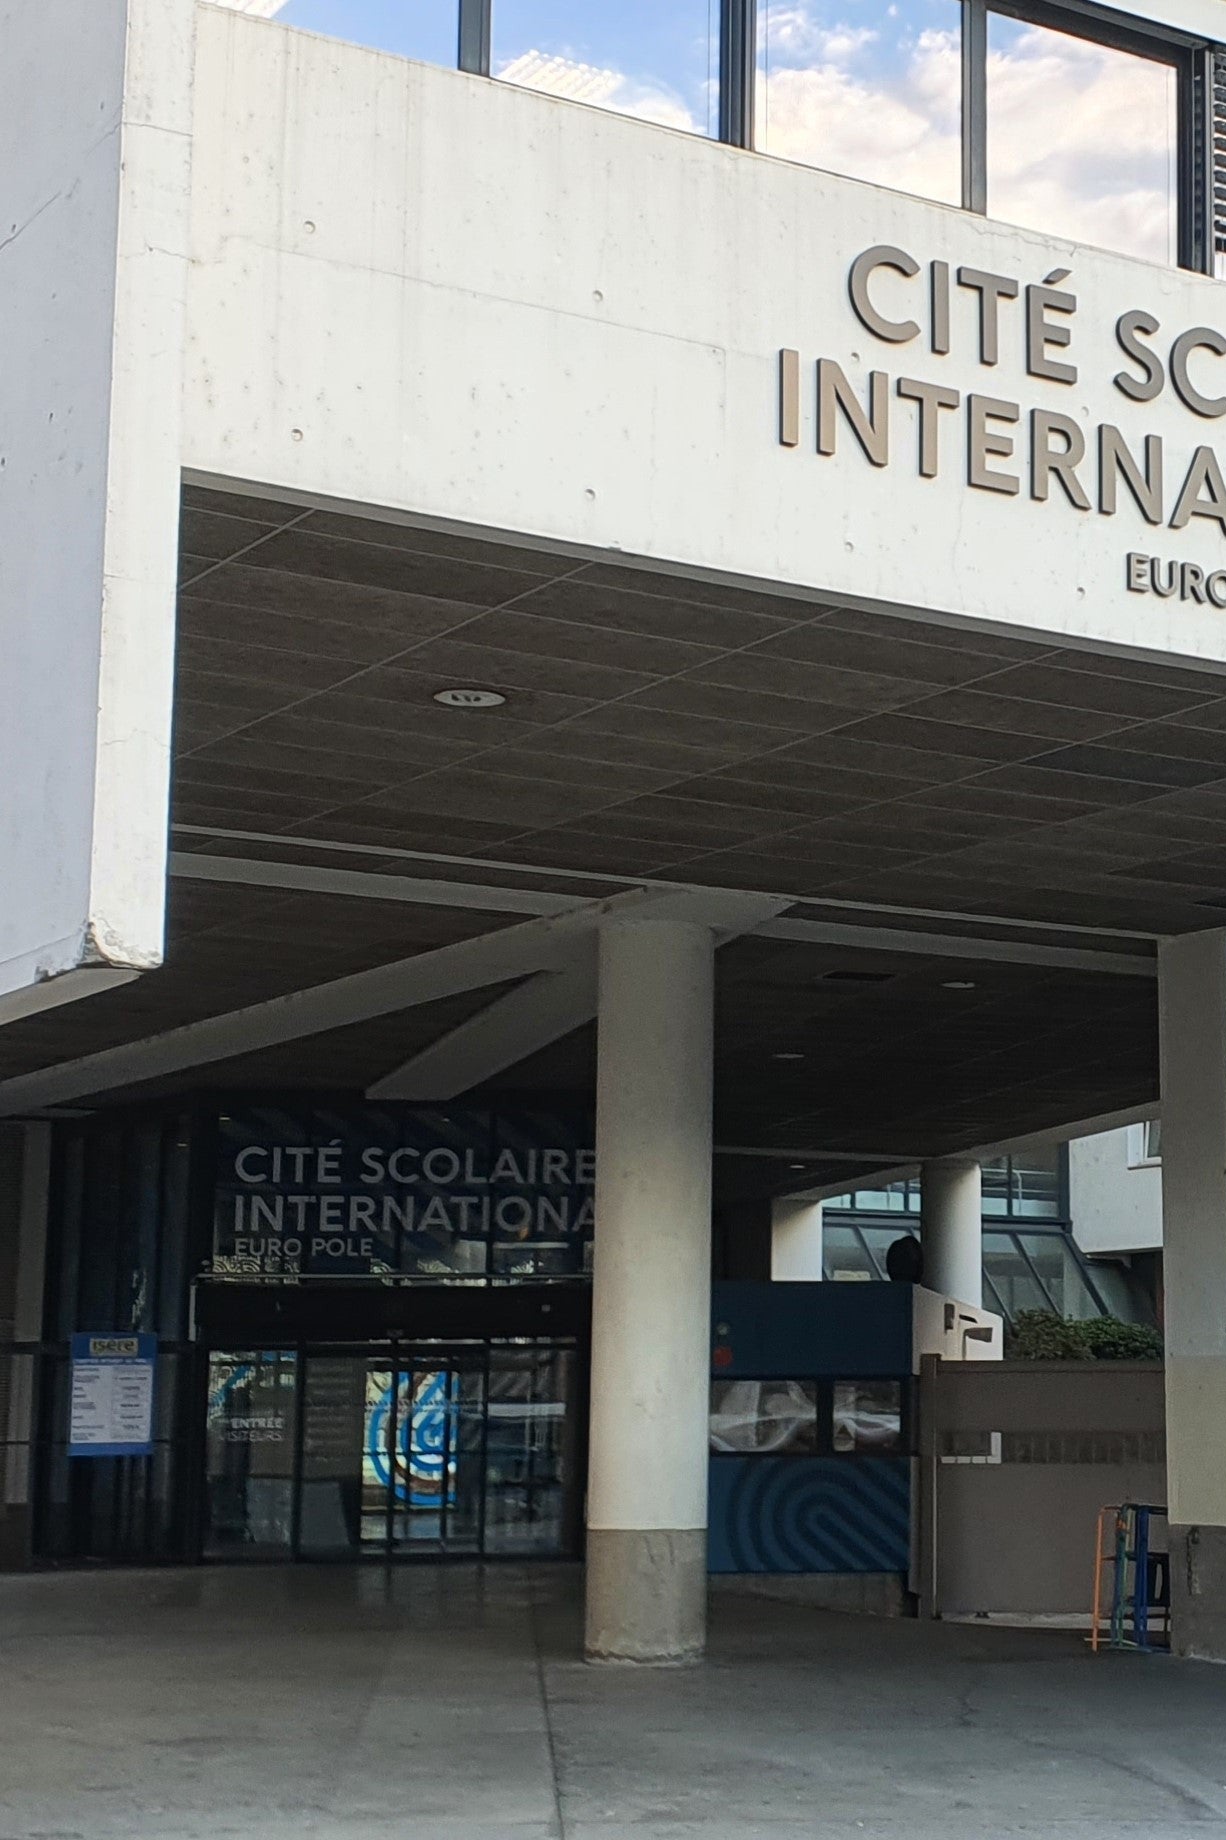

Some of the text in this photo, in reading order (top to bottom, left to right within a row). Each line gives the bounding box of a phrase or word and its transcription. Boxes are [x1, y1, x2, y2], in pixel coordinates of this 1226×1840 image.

[847, 245, 1079, 386] CITÉ
[235, 1138, 596, 1185] CITÉ SCOLAIRE
[235, 1237, 373, 1257] EURO POLE
